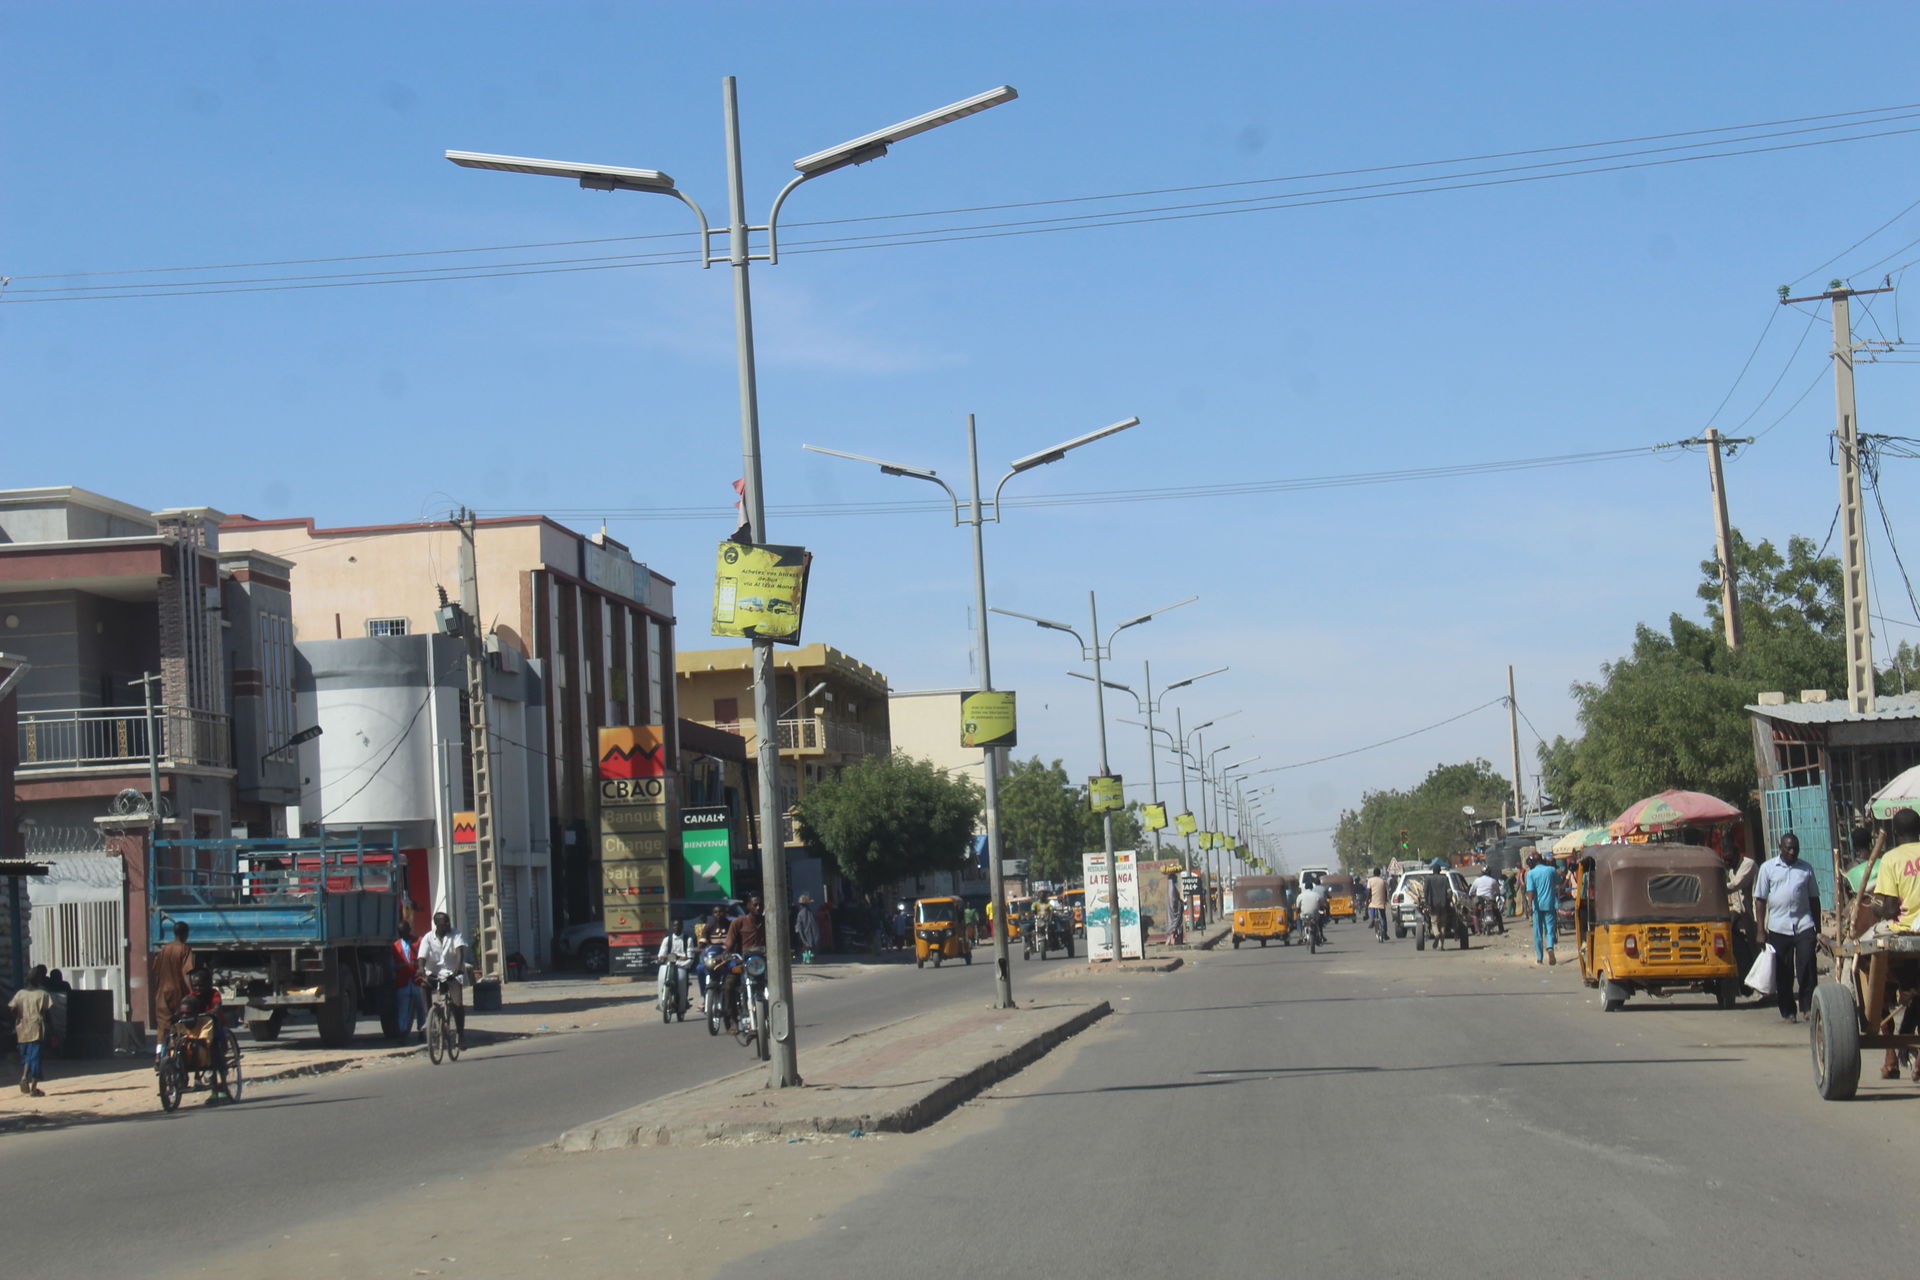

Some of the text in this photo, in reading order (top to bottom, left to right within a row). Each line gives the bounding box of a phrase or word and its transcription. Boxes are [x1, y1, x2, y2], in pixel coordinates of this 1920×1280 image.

[602, 779, 662, 799] CBAO
[605, 811, 662, 825] Banque
[684, 813, 725, 824] CANAL+
[605, 838, 662, 854] Change
[684, 839, 728, 849] BIENVENUE
[1090, 873, 1133, 884] LA TENGA
